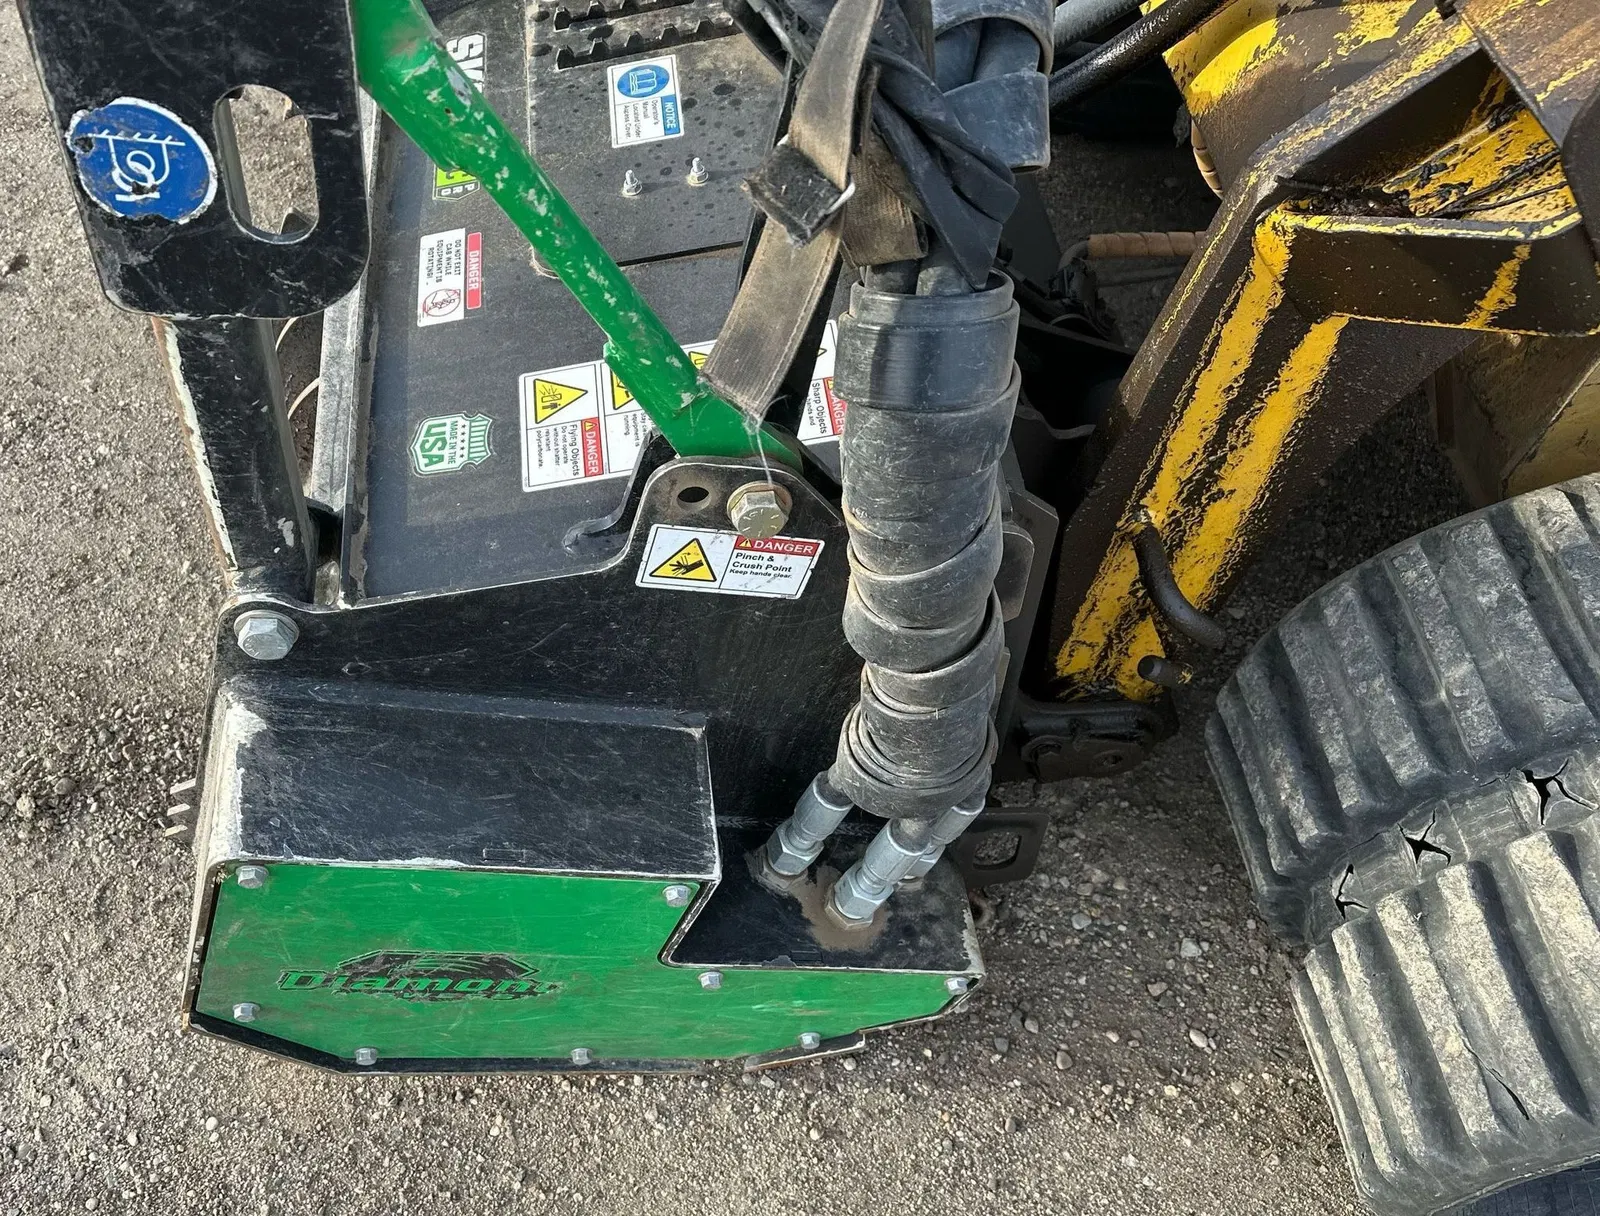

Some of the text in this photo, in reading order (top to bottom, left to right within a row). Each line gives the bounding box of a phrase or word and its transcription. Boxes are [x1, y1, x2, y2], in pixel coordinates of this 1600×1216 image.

[665, 101, 677, 129] NOTICE
[441, 183, 476, 196] PRO
[455, 240, 461, 248] DO
[468, 250, 480, 290] DANGER
[812, 382, 827, 434] Sharp Objects
[829, 390, 846, 434] ANGER
[632, 413, 640, 441] equipment
[420, 422, 448, 468] USA
[447, 420, 458, 464] MADE IN THE
[561, 444, 569, 464] operate
[568, 424, 581, 476] Flying Objects
[585, 431, 599, 474] DANGER
[735, 552, 765, 562] Pinch
[753, 540, 814, 553] DANGER
[732, 561, 792, 572] Crush Point
